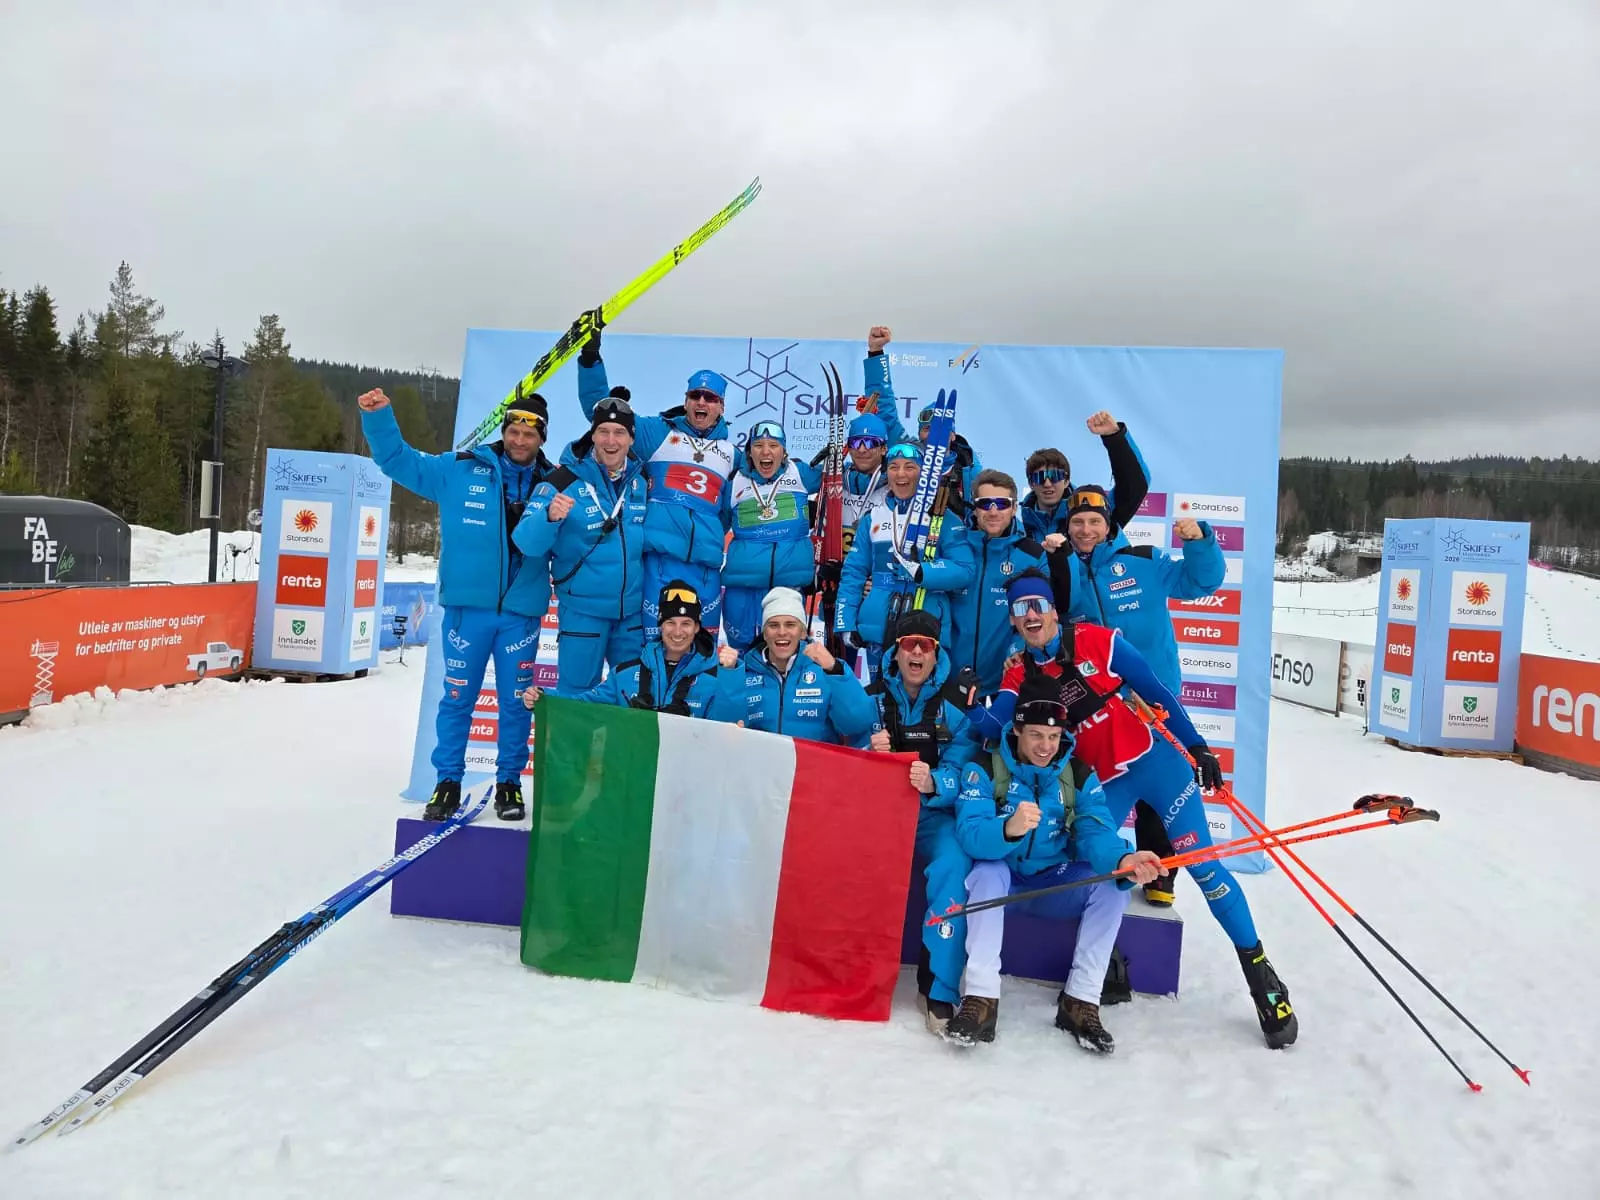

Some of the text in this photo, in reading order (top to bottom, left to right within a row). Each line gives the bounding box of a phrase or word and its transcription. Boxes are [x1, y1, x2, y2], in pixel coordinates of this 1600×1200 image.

[880, 357, 889, 382] Audi
[794, 393, 918, 418] SKIFT
[291, 473, 327, 483] SKIFEST
[685, 470, 709, 494] 3
[913, 444, 936, 513] SALOMON
[924, 445, 947, 513] SALOMON
[23, 517, 50, 540] FA
[32, 540, 58, 563] BE
[1463, 544, 1502, 554] SKIFEST
[55, 545, 76, 578] Live
[281, 575, 322, 589] renta
[356, 578, 375, 591] renta
[78, 614, 206, 636] Utleie av maskiner og utstyr
[836, 602, 845, 629] Audi
[277, 636, 317, 646] Innlandet
[447, 629, 471, 650] EA7
[1183, 625, 1222, 638] renta
[75, 633, 183, 657] for bedrifter og private
[1388, 643, 1412, 657] renta
[1182, 657, 1232, 669] StoraEnso
[1452, 650, 1495, 663] renta
[1182, 685, 1219, 700] frisikt
[1448, 713, 1489, 723] Innlandet
[1532, 684, 1600, 742] ren
[1173, 834, 1196, 850] enel
[288, 916, 337, 958] SALOMON
